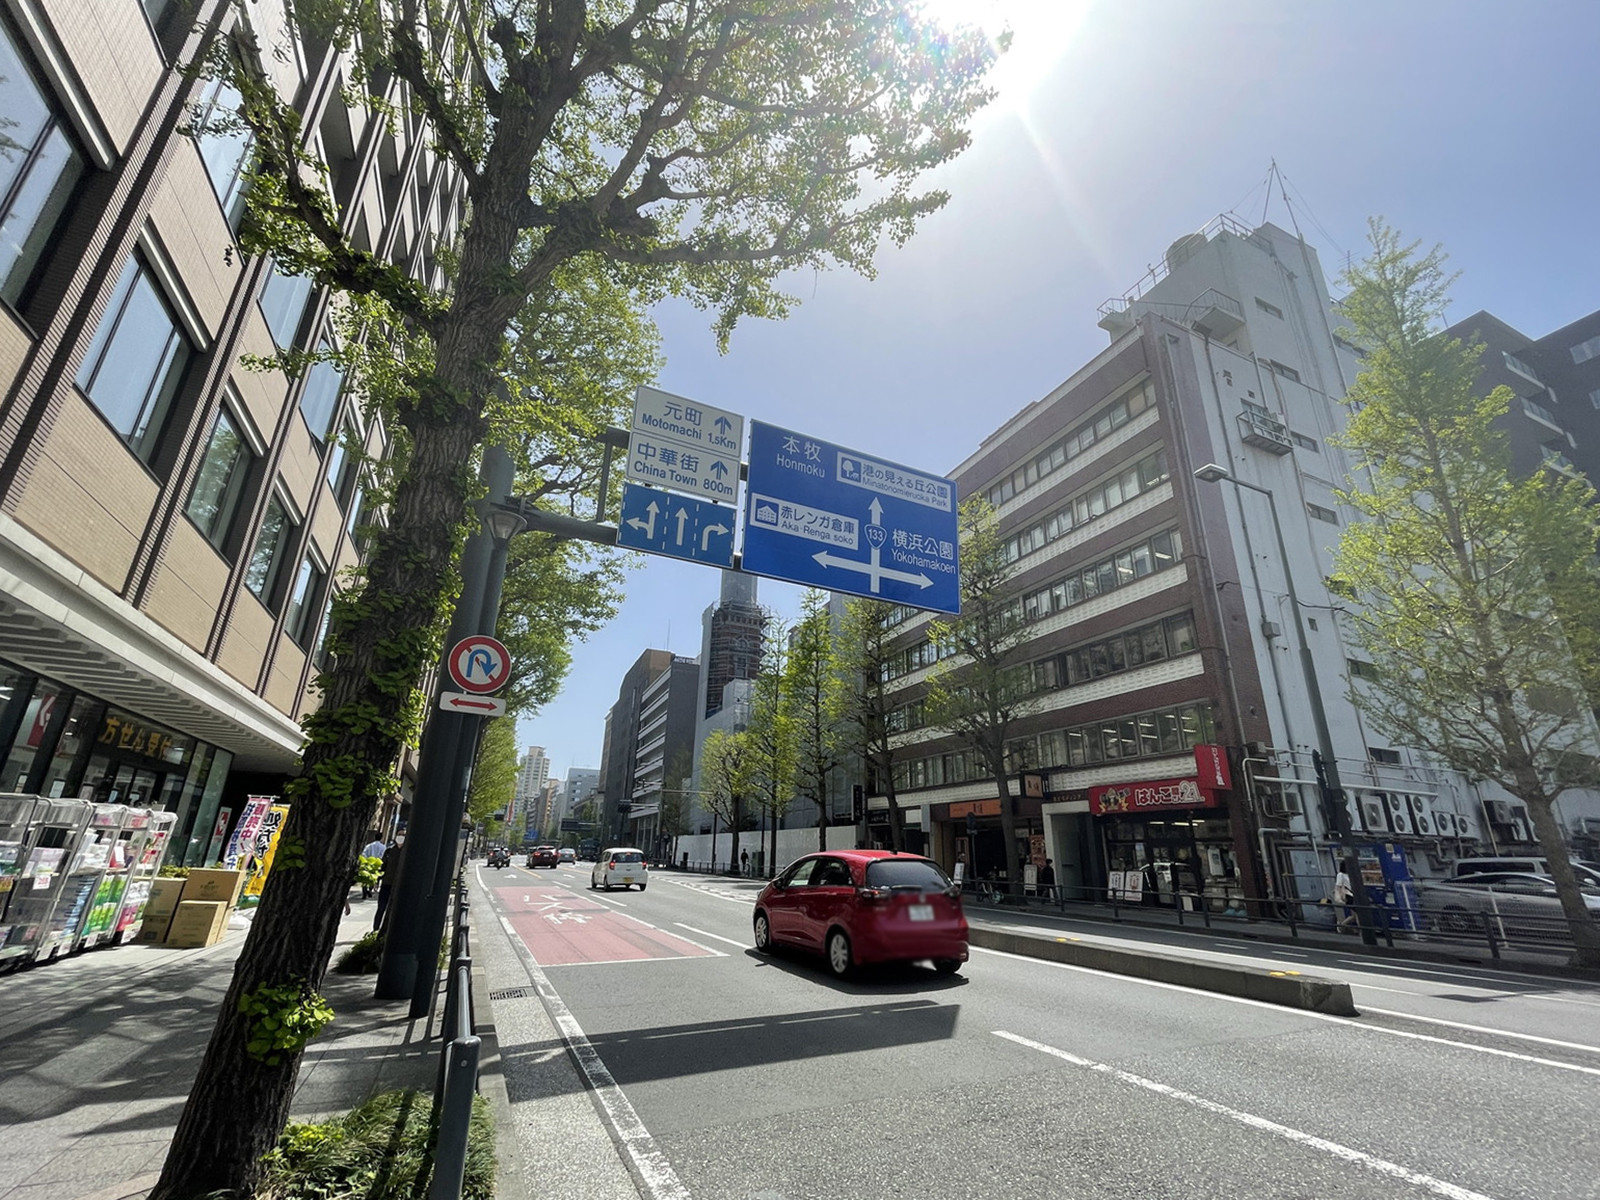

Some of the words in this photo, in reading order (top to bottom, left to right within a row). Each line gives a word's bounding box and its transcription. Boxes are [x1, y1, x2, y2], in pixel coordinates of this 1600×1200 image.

[664, 401, 703, 426] 元町
[642, 413, 702, 440] Motomachi
[708, 432, 737, 450] 1.5Km
[637, 442, 700, 473] 中華街
[782, 436, 821, 463] 本牧
[634, 461, 666, 478] China
[669, 469, 697, 487] Town
[703, 478, 733, 496] 800m
[776, 453, 825, 478] Honmoku
[862, 463, 948, 499] 港の見える丘公園
[932, 496, 948, 508] Park
[781, 505, 855, 535] 赤レンガ倉庫
[833, 533, 854, 546] soko
[868, 528, 884, 541] 133
[892, 528, 954, 560] 横浜公園
[890, 548, 956, 575] Yokohamakoen
